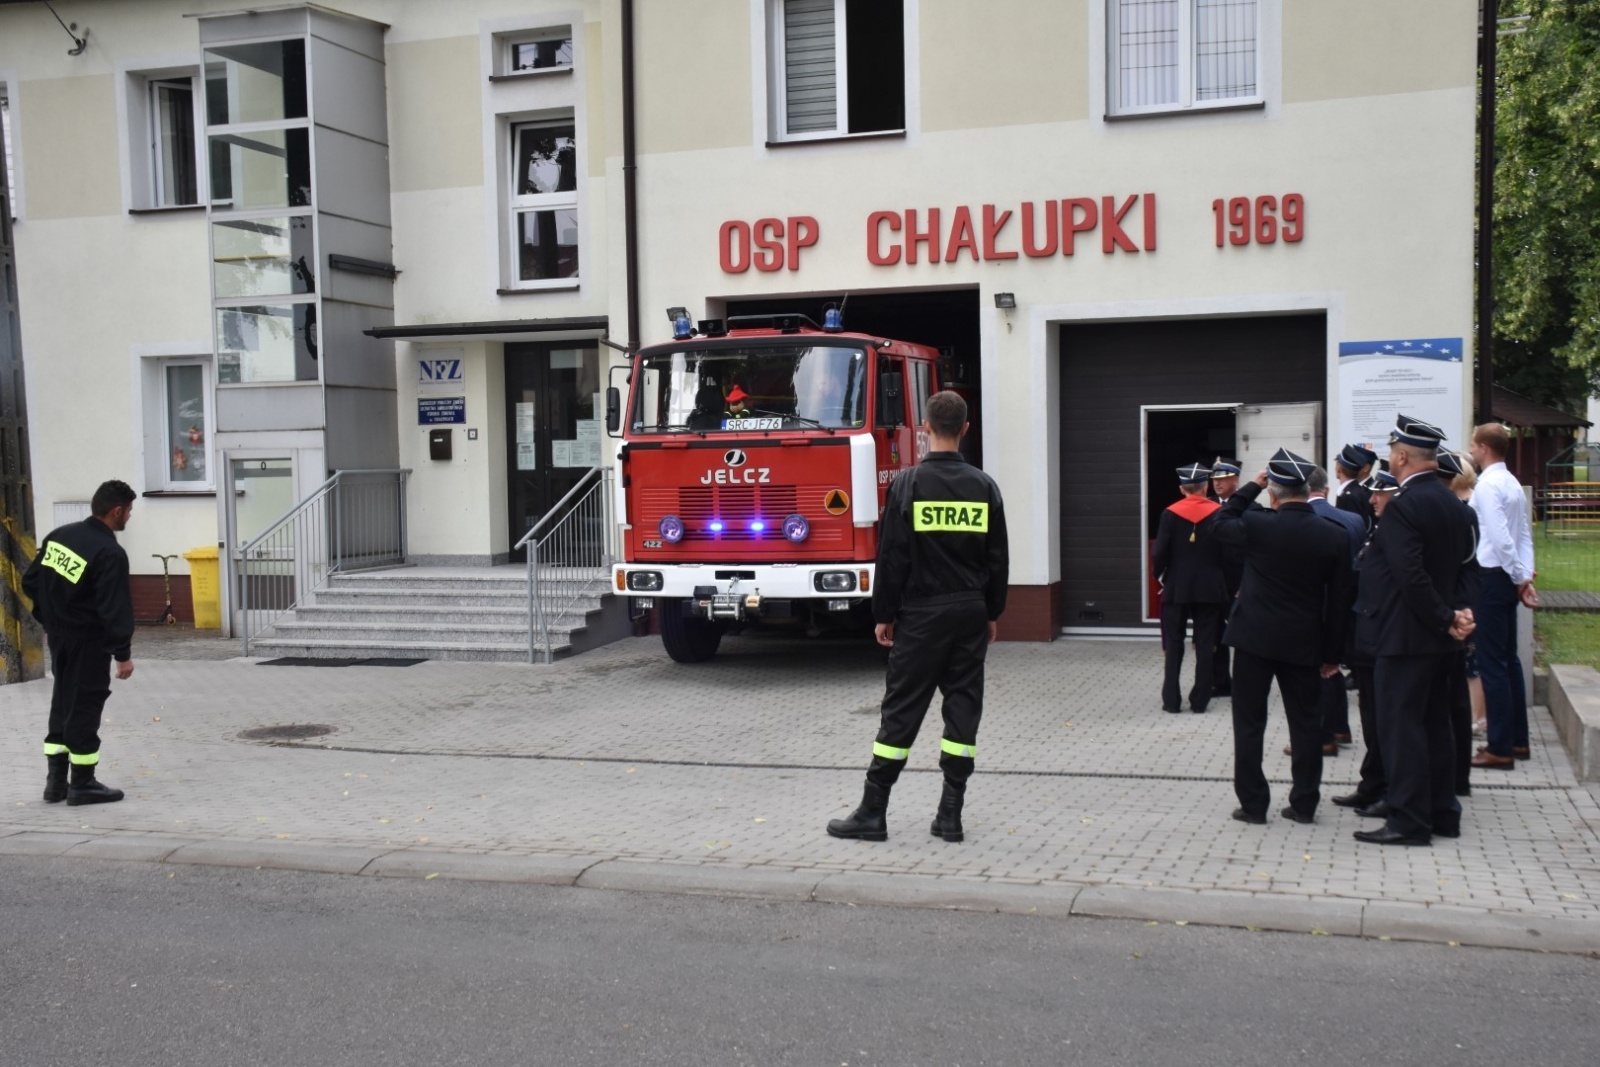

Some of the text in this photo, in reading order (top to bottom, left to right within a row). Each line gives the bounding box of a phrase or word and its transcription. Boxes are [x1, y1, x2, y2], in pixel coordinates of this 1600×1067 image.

[719, 193, 1304, 274] OSP CHAŁUPKI 1969
[419, 359, 462, 380] NFZ
[700, 467, 770, 485] JELCZ
